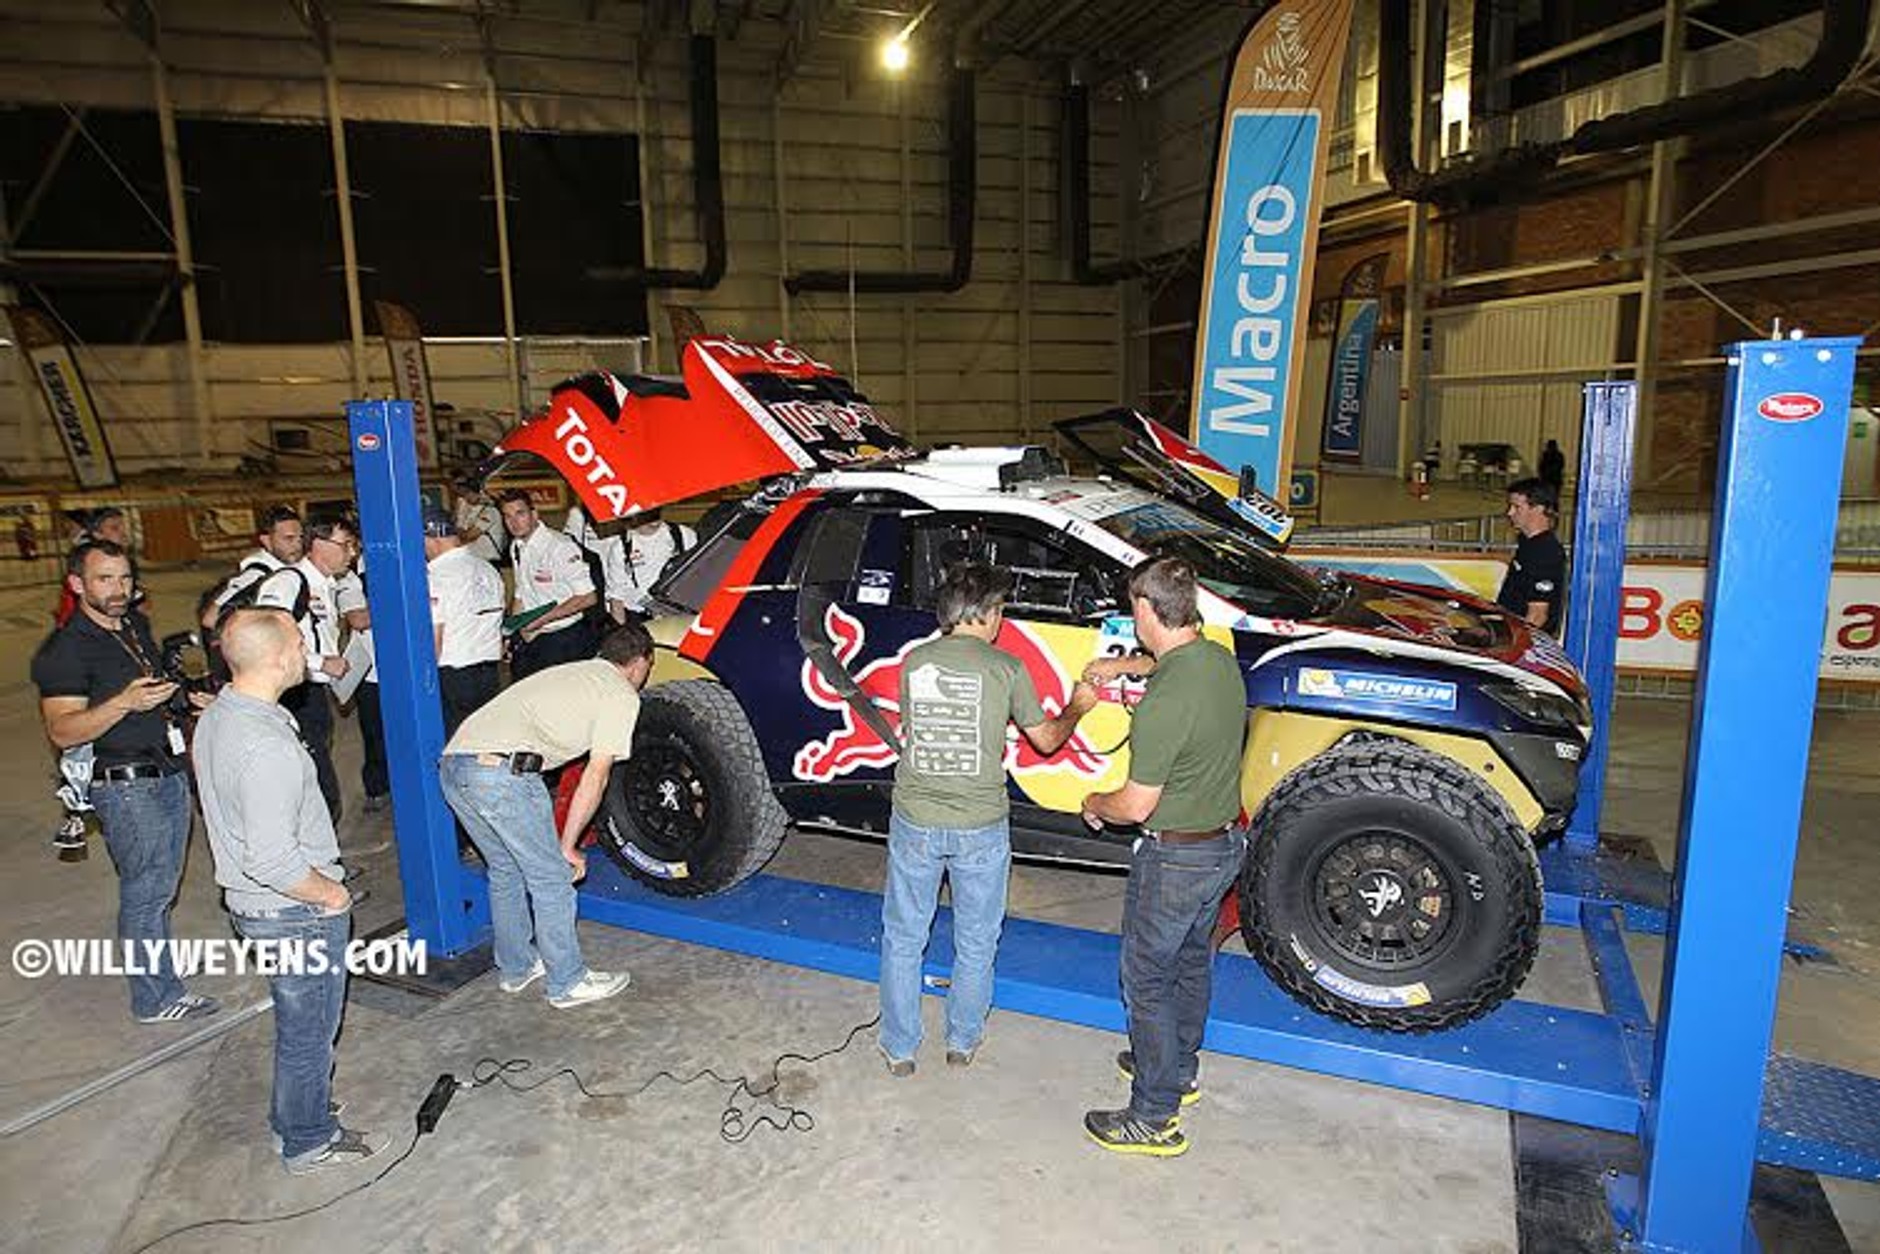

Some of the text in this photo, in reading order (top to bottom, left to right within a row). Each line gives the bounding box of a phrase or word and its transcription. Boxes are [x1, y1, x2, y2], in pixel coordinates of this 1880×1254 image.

[1253, 66, 1312, 93] DAKAR
[1209, 184, 1296, 437] Macro
[1333, 334, 1362, 438] Argentina
[555, 406, 642, 517] TOTA
[1344, 678, 1452, 701] MICHELIN
